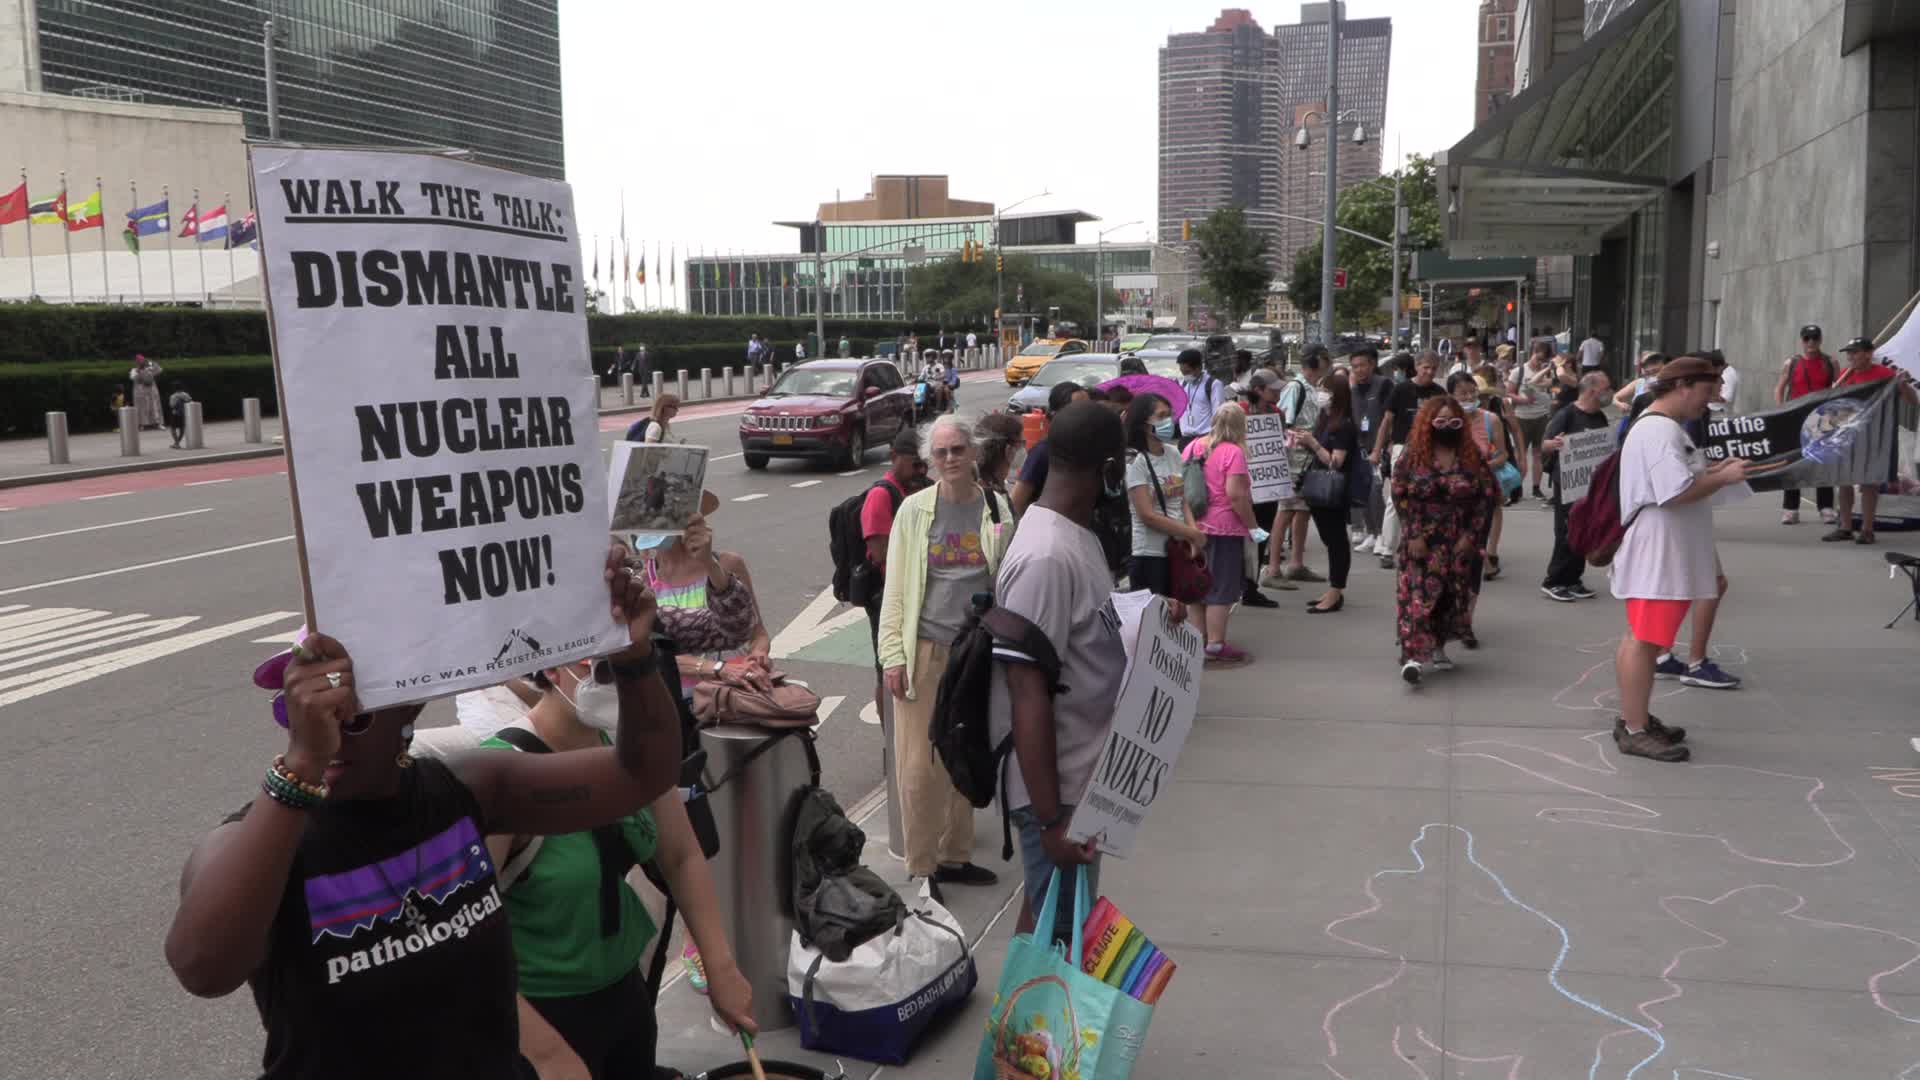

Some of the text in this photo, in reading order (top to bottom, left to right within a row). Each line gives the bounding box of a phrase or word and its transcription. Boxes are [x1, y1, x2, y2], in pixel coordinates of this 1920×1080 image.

[280, 179, 564, 235] WALK THE TALK:
[291, 250, 574, 313] DISMANTLE
[434, 325, 519, 379] ALL
[354, 396, 575, 462] NUCLEAR
[1249, 440, 1286, 458] UCLEAR
[1726, 438, 1770, 457] First
[1733, 416, 1765, 434] the
[355, 462, 584, 539] WEAPONS
[438, 534, 555, 605] NOW!
[396, 635, 596, 689] NYC WAR RESISTERS LEAGUE
[1136, 686, 1174, 745] NO
[1096, 731, 1169, 807] NUKES
[326, 885, 503, 984] pathological
[1084, 924, 1120, 974] CLIMATE
[897, 1000, 918, 1023] BED
[917, 985, 939, 1011] BATH
